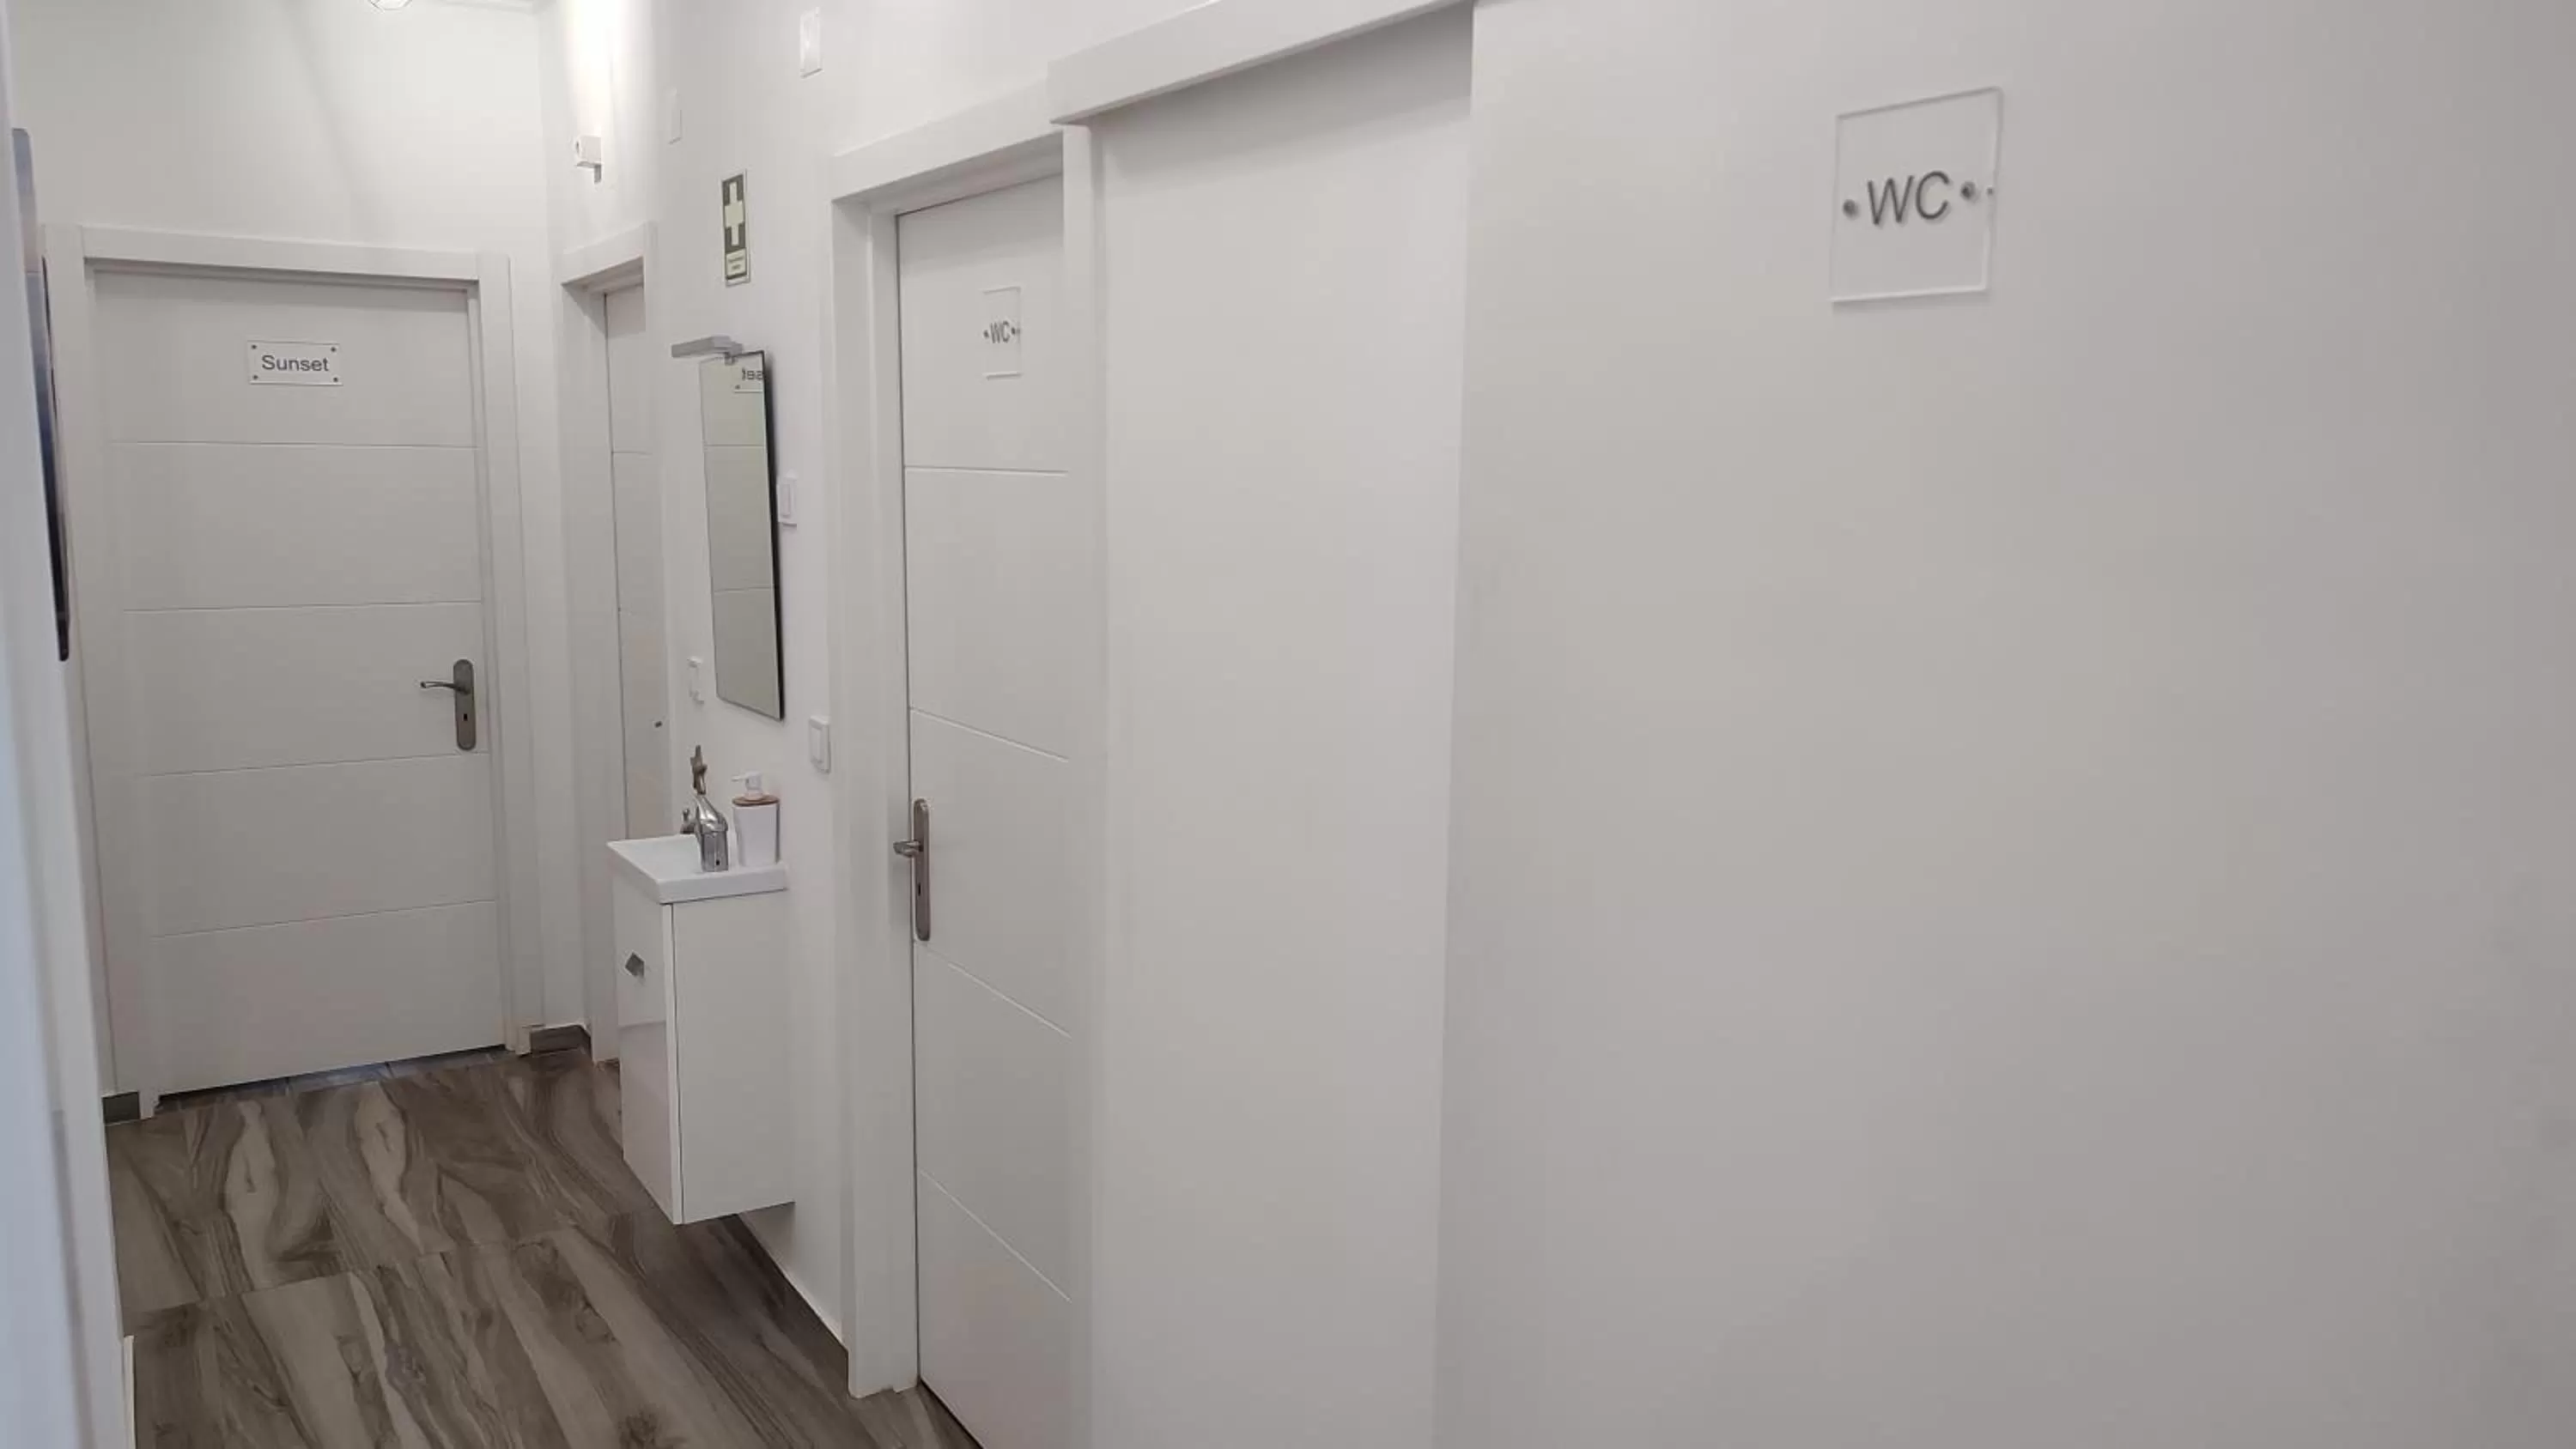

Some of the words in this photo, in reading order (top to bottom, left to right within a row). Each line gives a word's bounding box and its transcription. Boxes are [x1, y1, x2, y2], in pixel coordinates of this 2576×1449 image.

[1867, 170, 1950, 226] WC
[989, 320, 1011, 343] WC
[261, 355, 330, 372] Sunset
